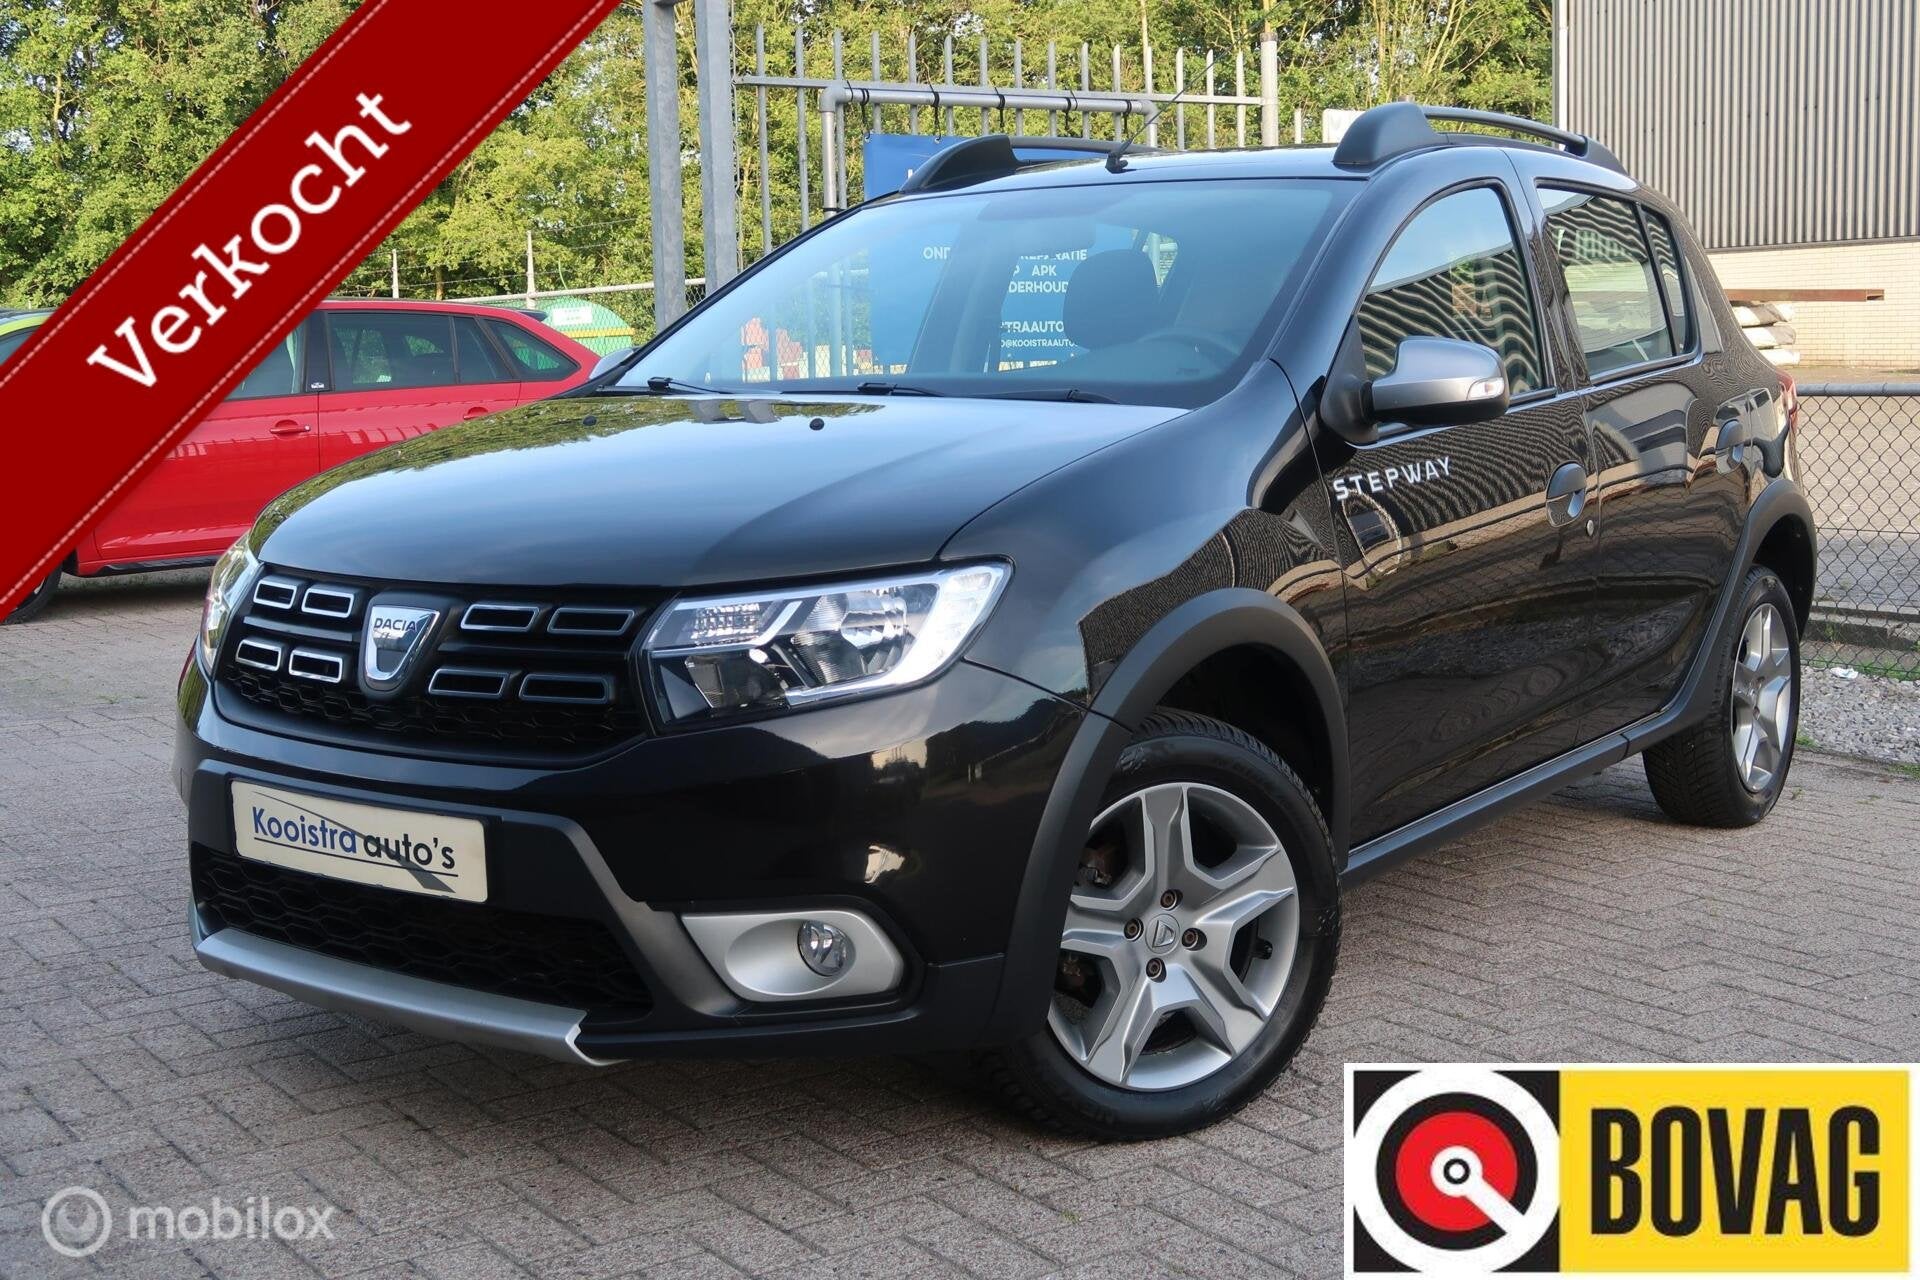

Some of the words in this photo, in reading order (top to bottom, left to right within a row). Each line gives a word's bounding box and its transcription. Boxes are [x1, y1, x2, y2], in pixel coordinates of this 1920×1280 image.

[1031, 264, 1057, 277] APK
[1332, 456, 1450, 501] STEPWAY
[373, 617, 417, 632] DACIA
[252, 806, 357, 854] Kooistra
[363, 833, 456, 870] auto's
